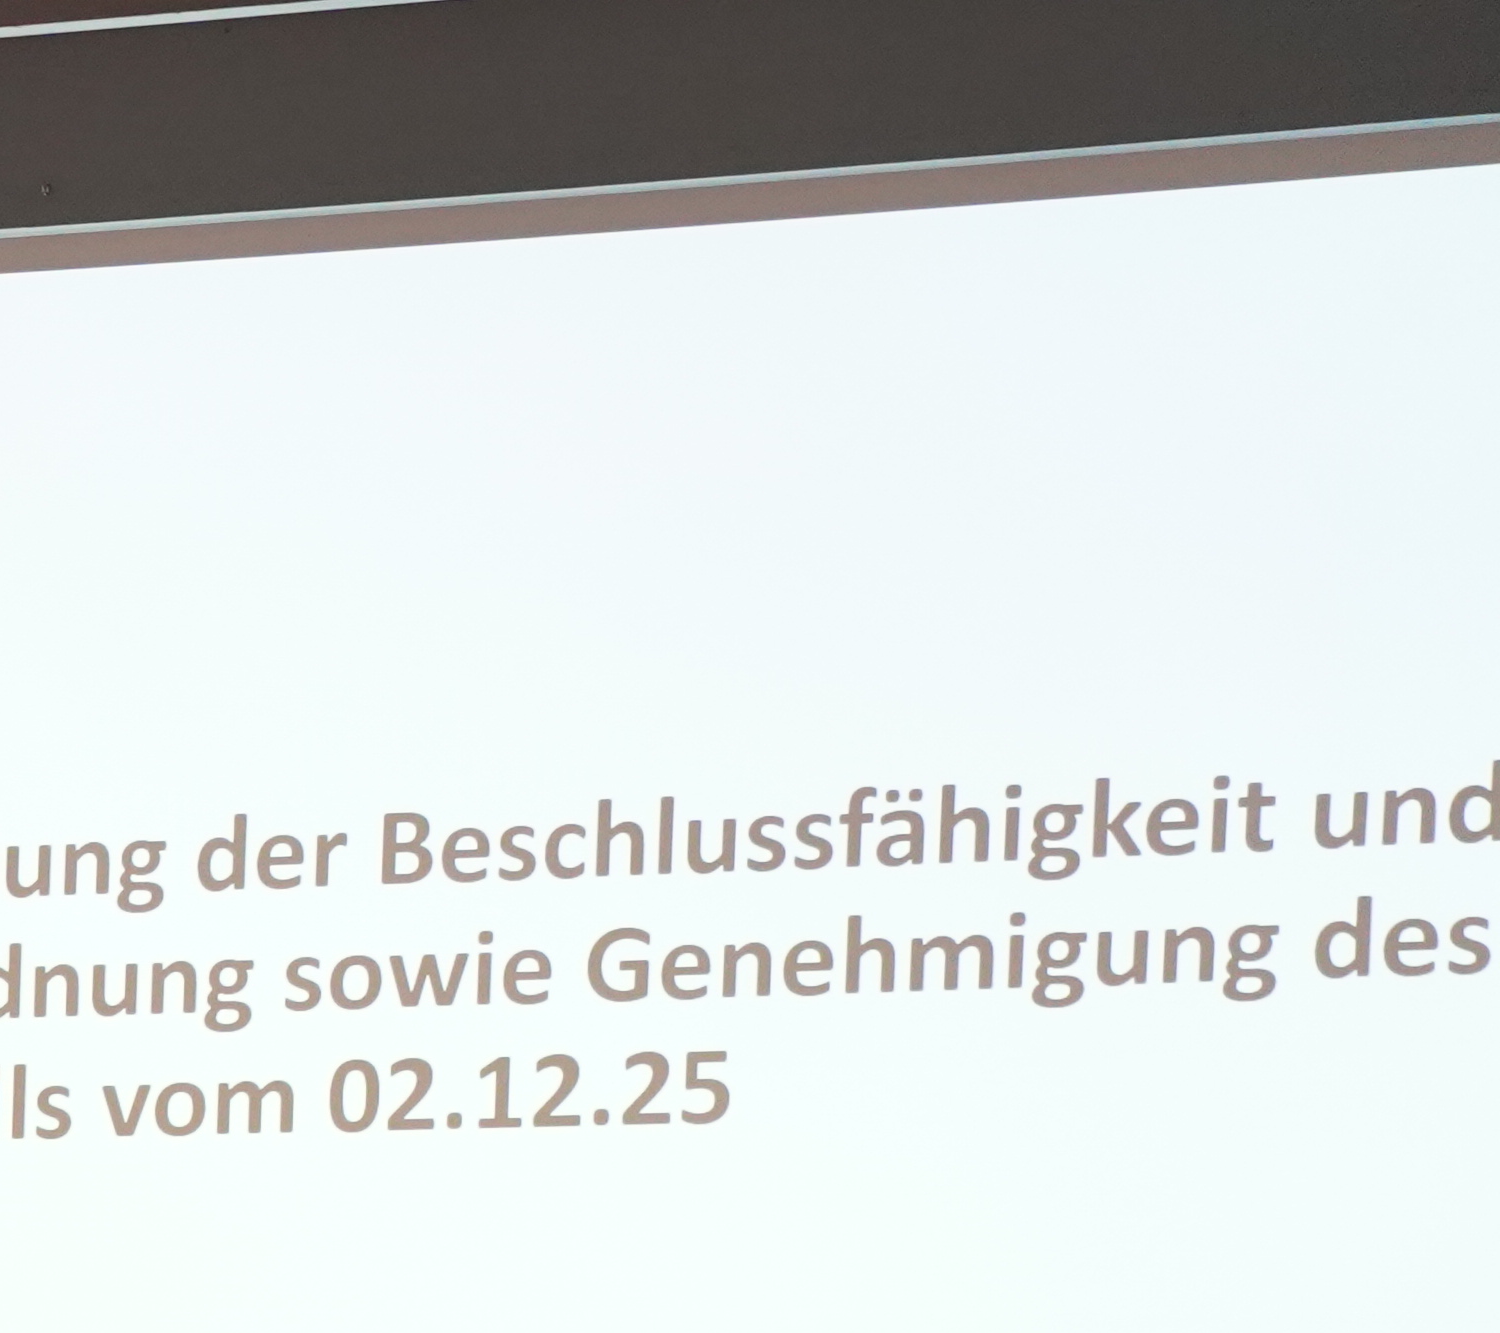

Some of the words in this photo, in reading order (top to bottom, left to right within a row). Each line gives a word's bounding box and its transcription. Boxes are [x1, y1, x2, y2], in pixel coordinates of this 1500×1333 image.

[197, 813, 348, 892] der
[381, 775, 1277, 886] Beschlussfähigkeit
[1314, 759, 1500, 850] und
[284, 930, 552, 1012] sowie
[587, 911, 1280, 1009] Genehmigung
[1314, 895, 1491, 979] des
[102, 1080, 294, 1137] vom
[329, 1050, 730, 1133] 02.12.25
